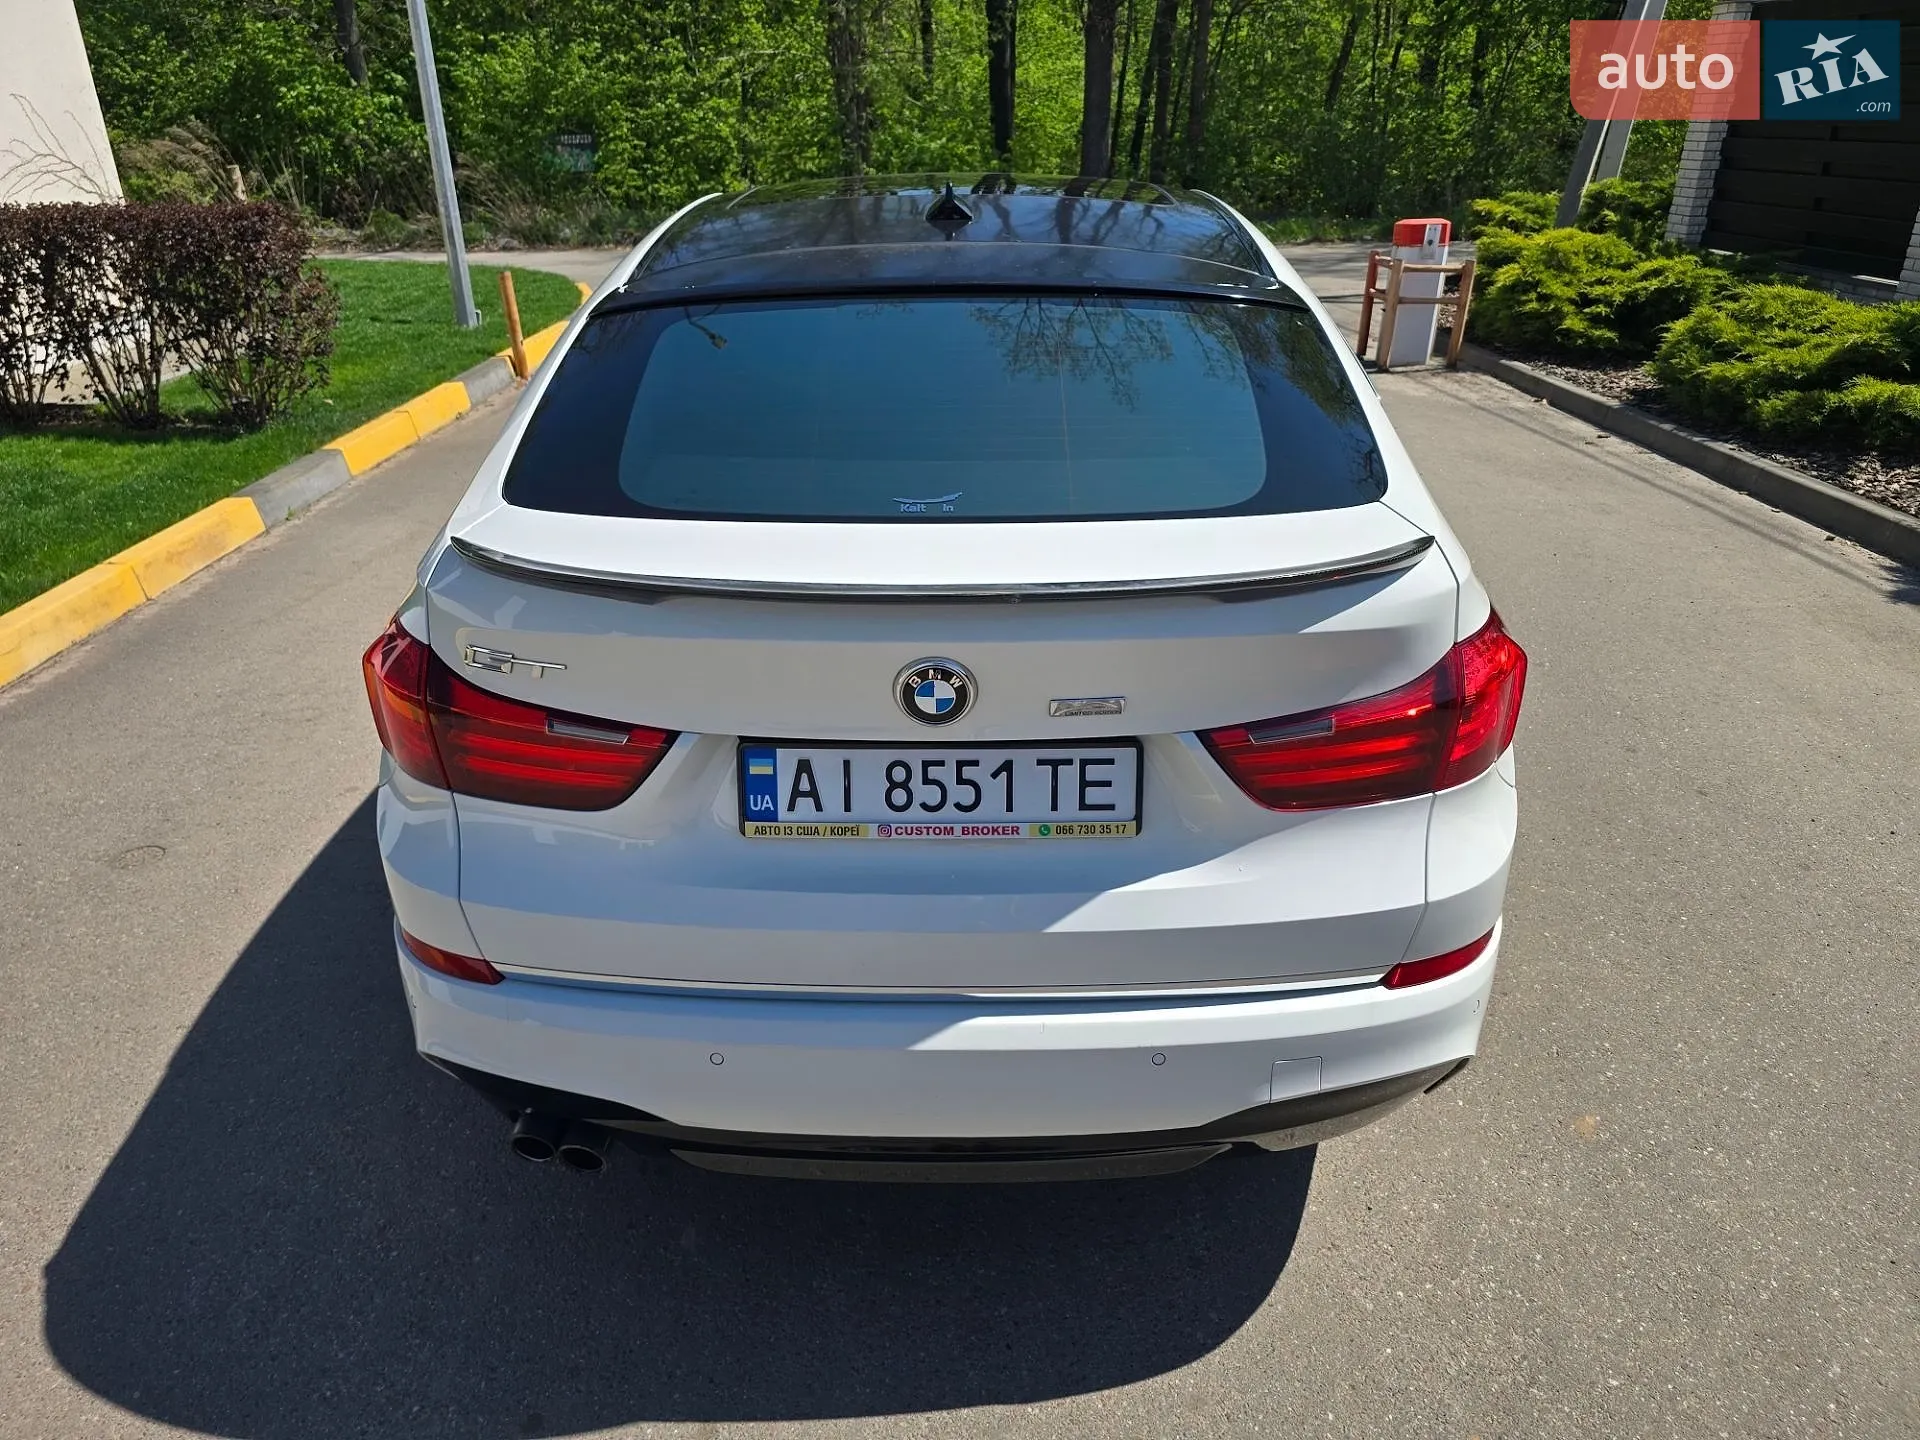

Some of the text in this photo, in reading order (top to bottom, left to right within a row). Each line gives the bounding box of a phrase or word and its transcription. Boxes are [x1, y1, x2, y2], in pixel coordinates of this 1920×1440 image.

[908, 668, 963, 689] BMW
[786, 757, 1116, 814] AI 8551 TE
[749, 794, 775, 812] UA
[753, 825, 781, 836] АВТО
[783, 825, 793, 836] ІЗ
[796, 825, 821, 837] США
[830, 824, 860, 837] КОРЕЇ
[1055, 824, 1127, 835] 066 730 35 17
